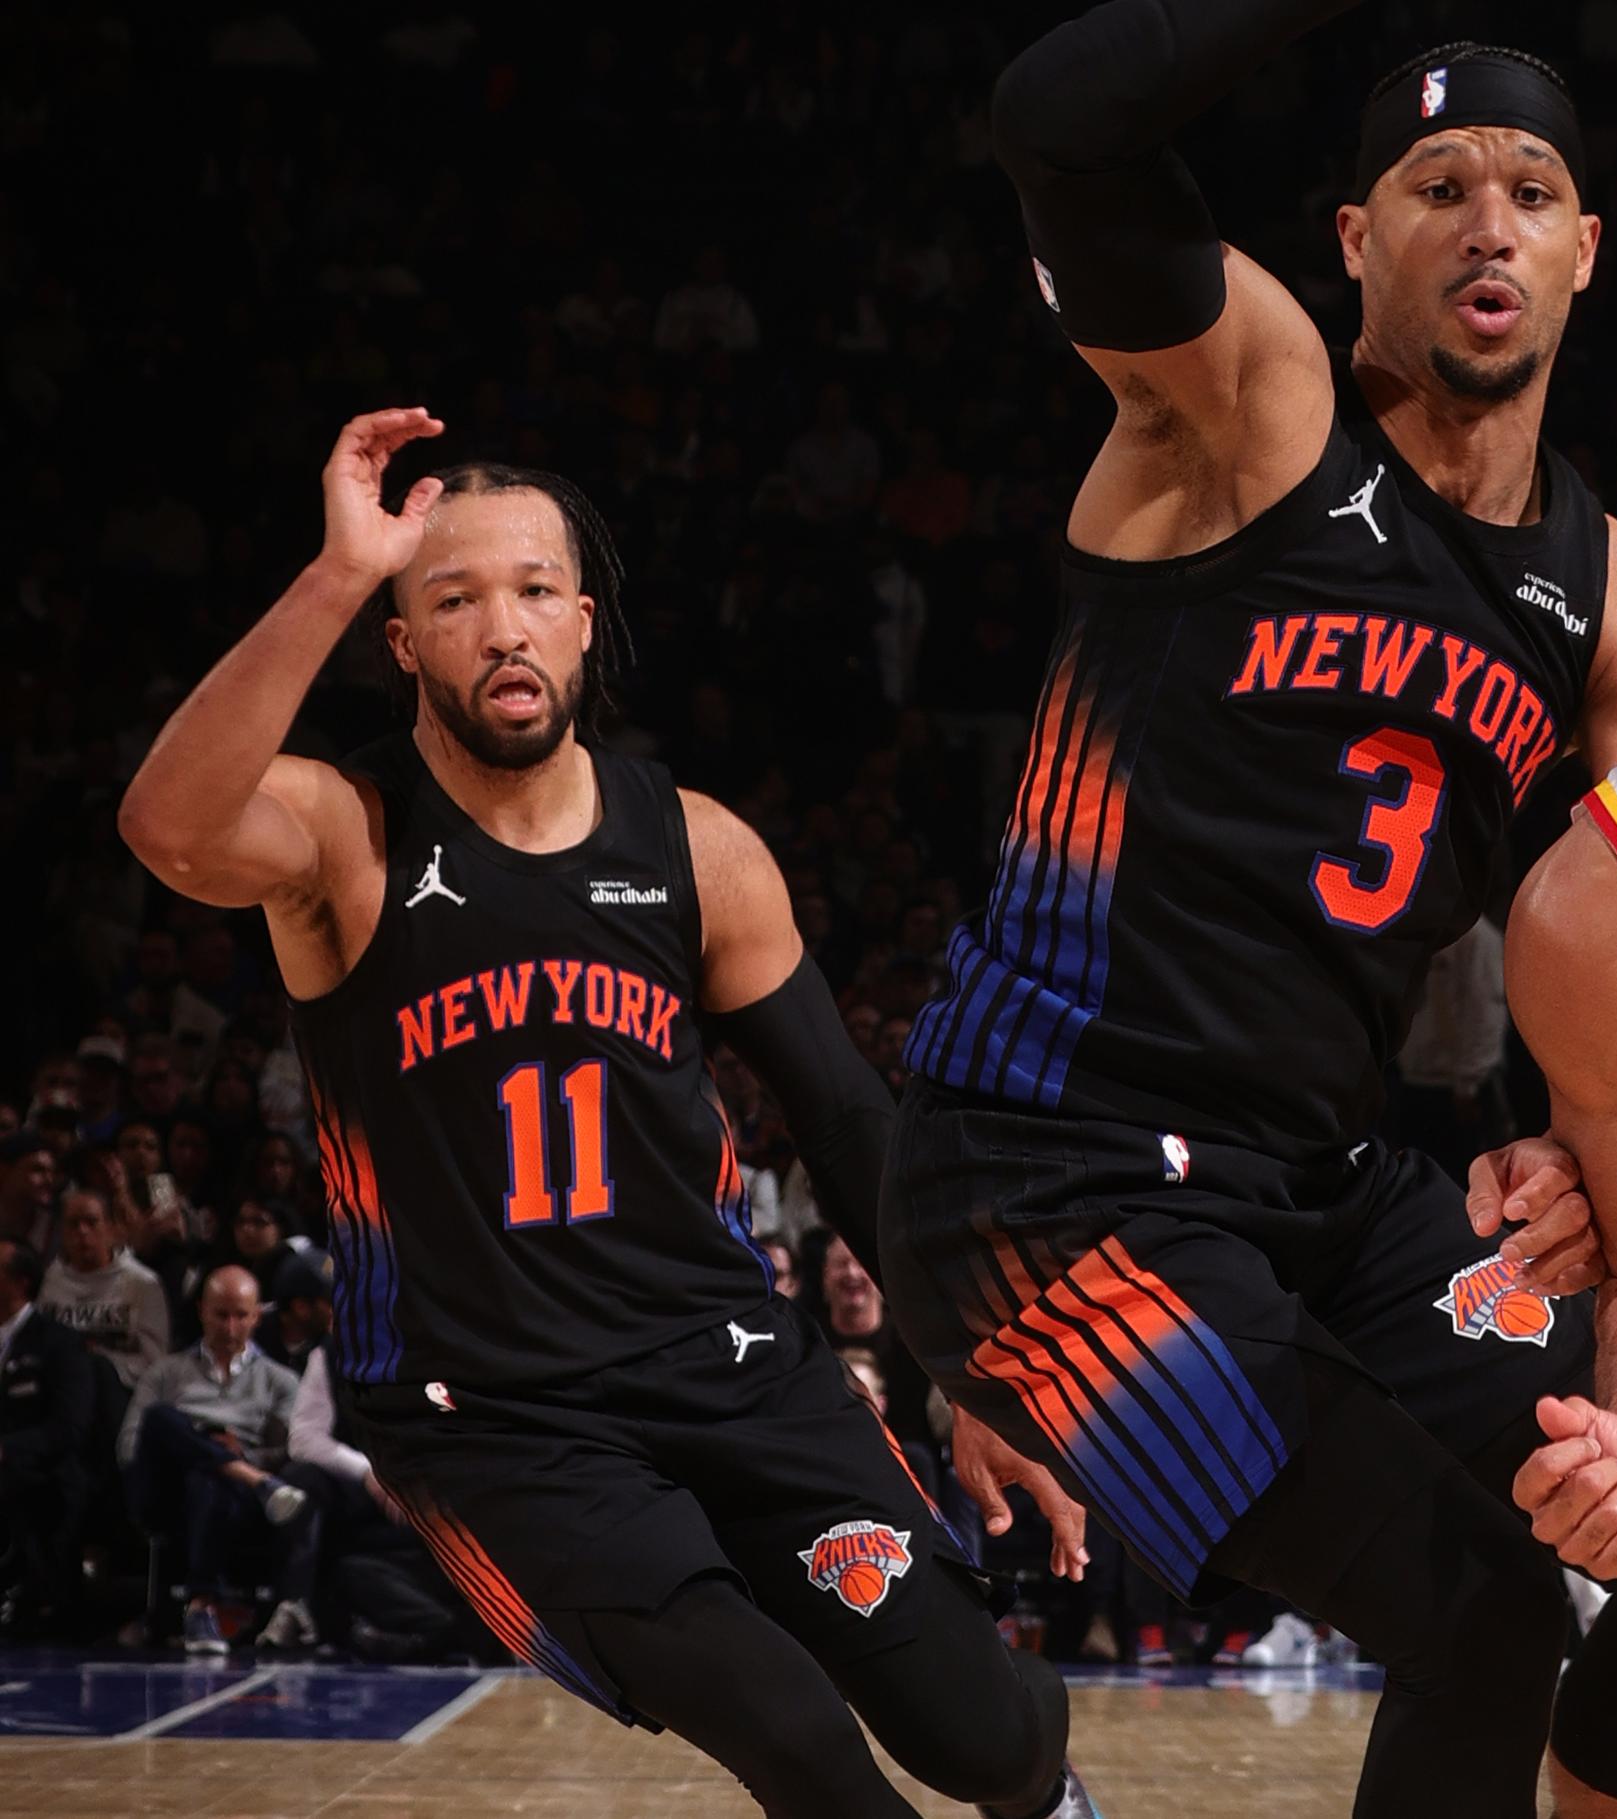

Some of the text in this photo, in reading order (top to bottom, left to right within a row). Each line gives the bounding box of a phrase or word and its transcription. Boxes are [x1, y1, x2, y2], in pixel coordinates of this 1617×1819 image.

[1515, 584, 1589, 636] abu dbi
[1225, 611, 1557, 808] NEW YORK
[1308, 726, 1448, 935] 3
[590, 886, 668, 904] abu dhabi
[396, 959, 682, 1073] NEW YORK
[497, 1058, 615, 1230] 11
[1453, 1260, 1516, 1331] KNIC
[811, 1527, 909, 1581] KNICKS
